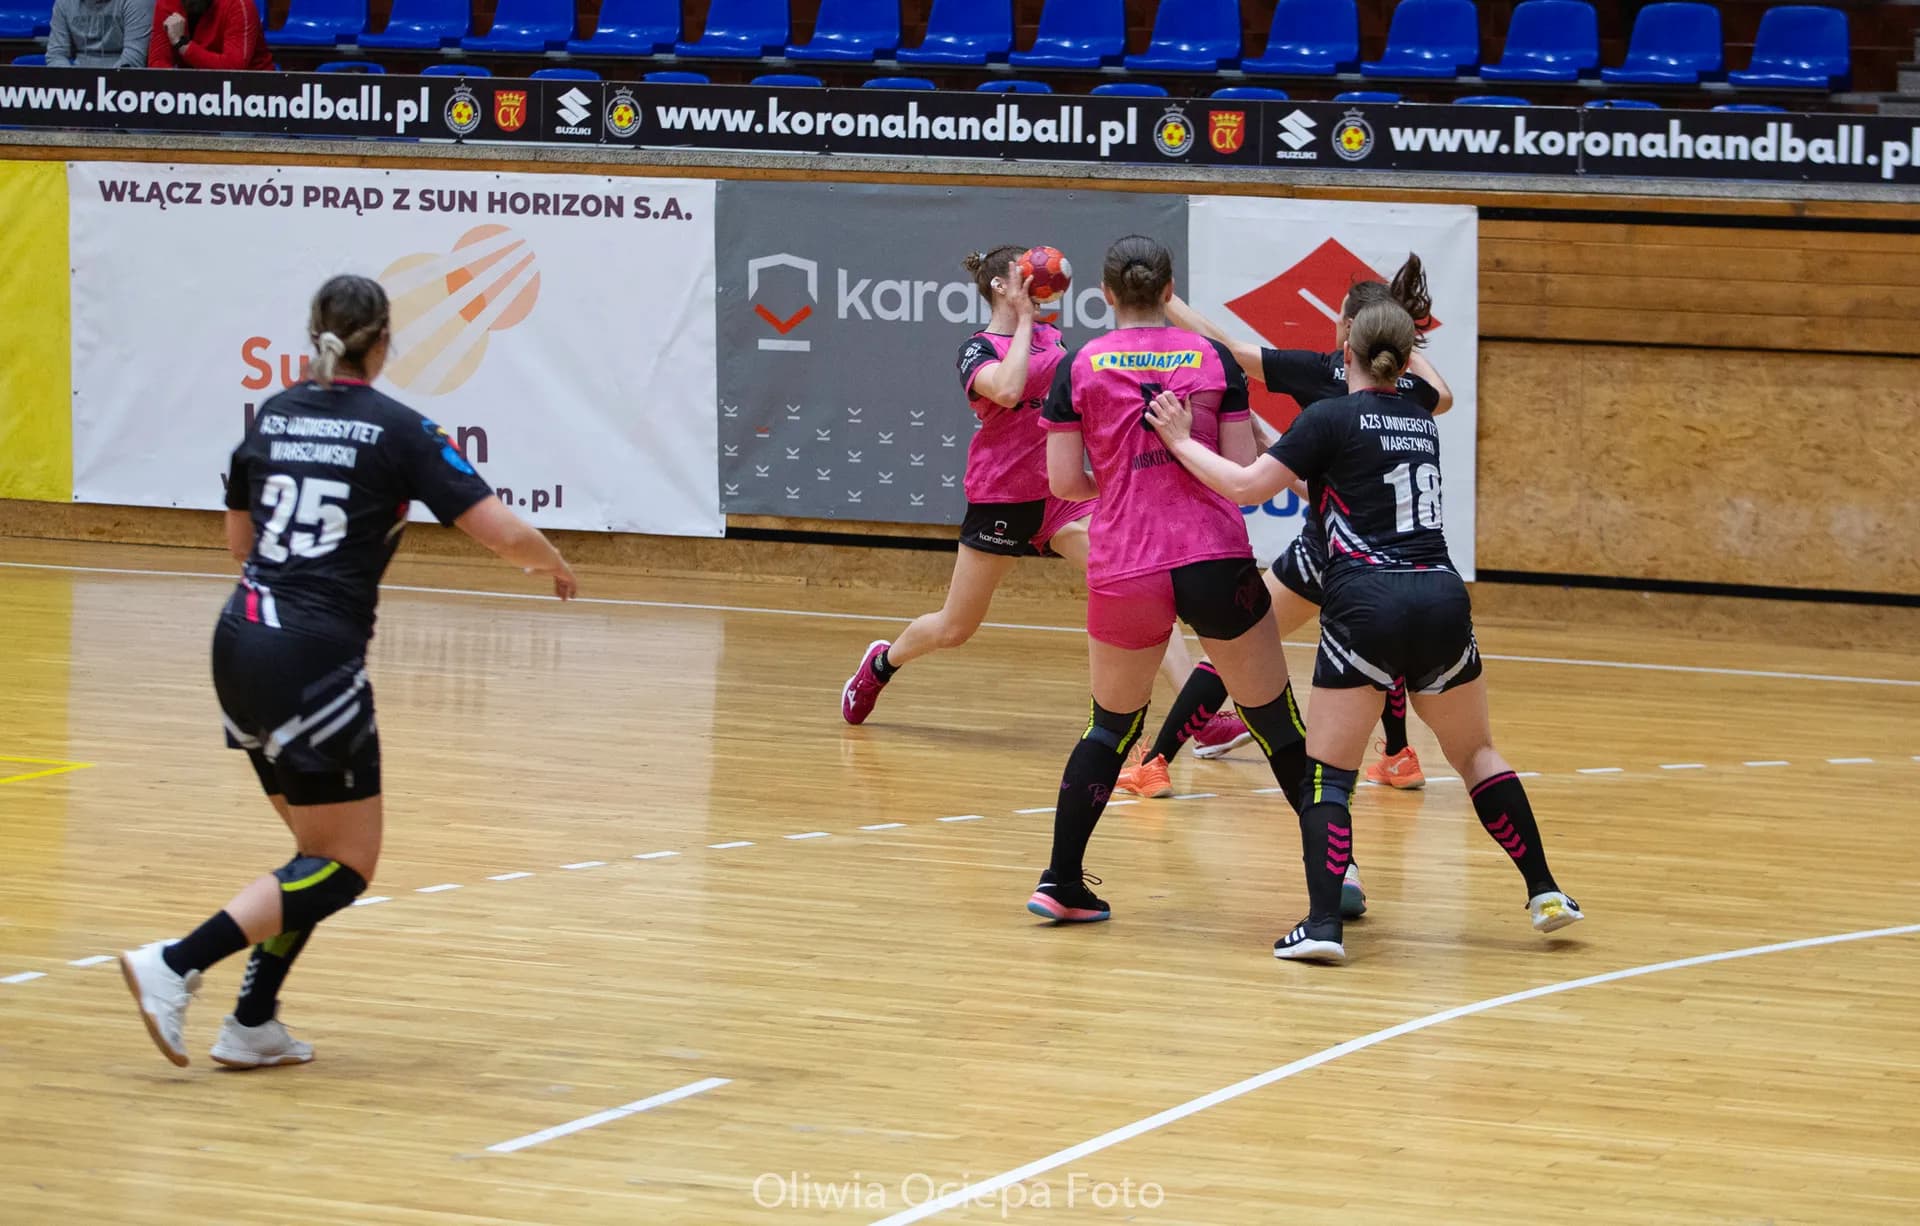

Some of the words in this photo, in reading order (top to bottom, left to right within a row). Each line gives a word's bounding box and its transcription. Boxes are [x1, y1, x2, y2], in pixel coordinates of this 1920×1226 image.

[0, 77, 429, 134] www.koronahandball.pl
[498, 106, 520, 127] CK
[655, 96, 1138, 157] www.koronahandball.pl
[555, 126, 591, 135] SUZUKI
[1212, 127, 1238, 149] CK
[1389, 115, 1920, 180] www.koronahandball.pl
[1276, 151, 1318, 160] SUZUKI
[99, 180, 202, 211] WŁĄCZ
[210, 177, 294, 208] SWÓJ
[303, 185, 384, 217] PRĄD
[392, 189, 411, 210] Z
[418, 189, 478, 213] SUN
[487, 191, 625, 219] HORIZON
[633, 196, 693, 221] S.A.
[837, 267, 1116, 329] karala
[241, 336, 310, 390] Su
[1119, 352, 1196, 368] LEWIATAN
[1360, 413, 1382, 430] AZS
[1381, 415, 1439, 437] UNIWERSYTE
[258, 474, 350, 563] 25
[1383, 463, 1441, 532] 18
